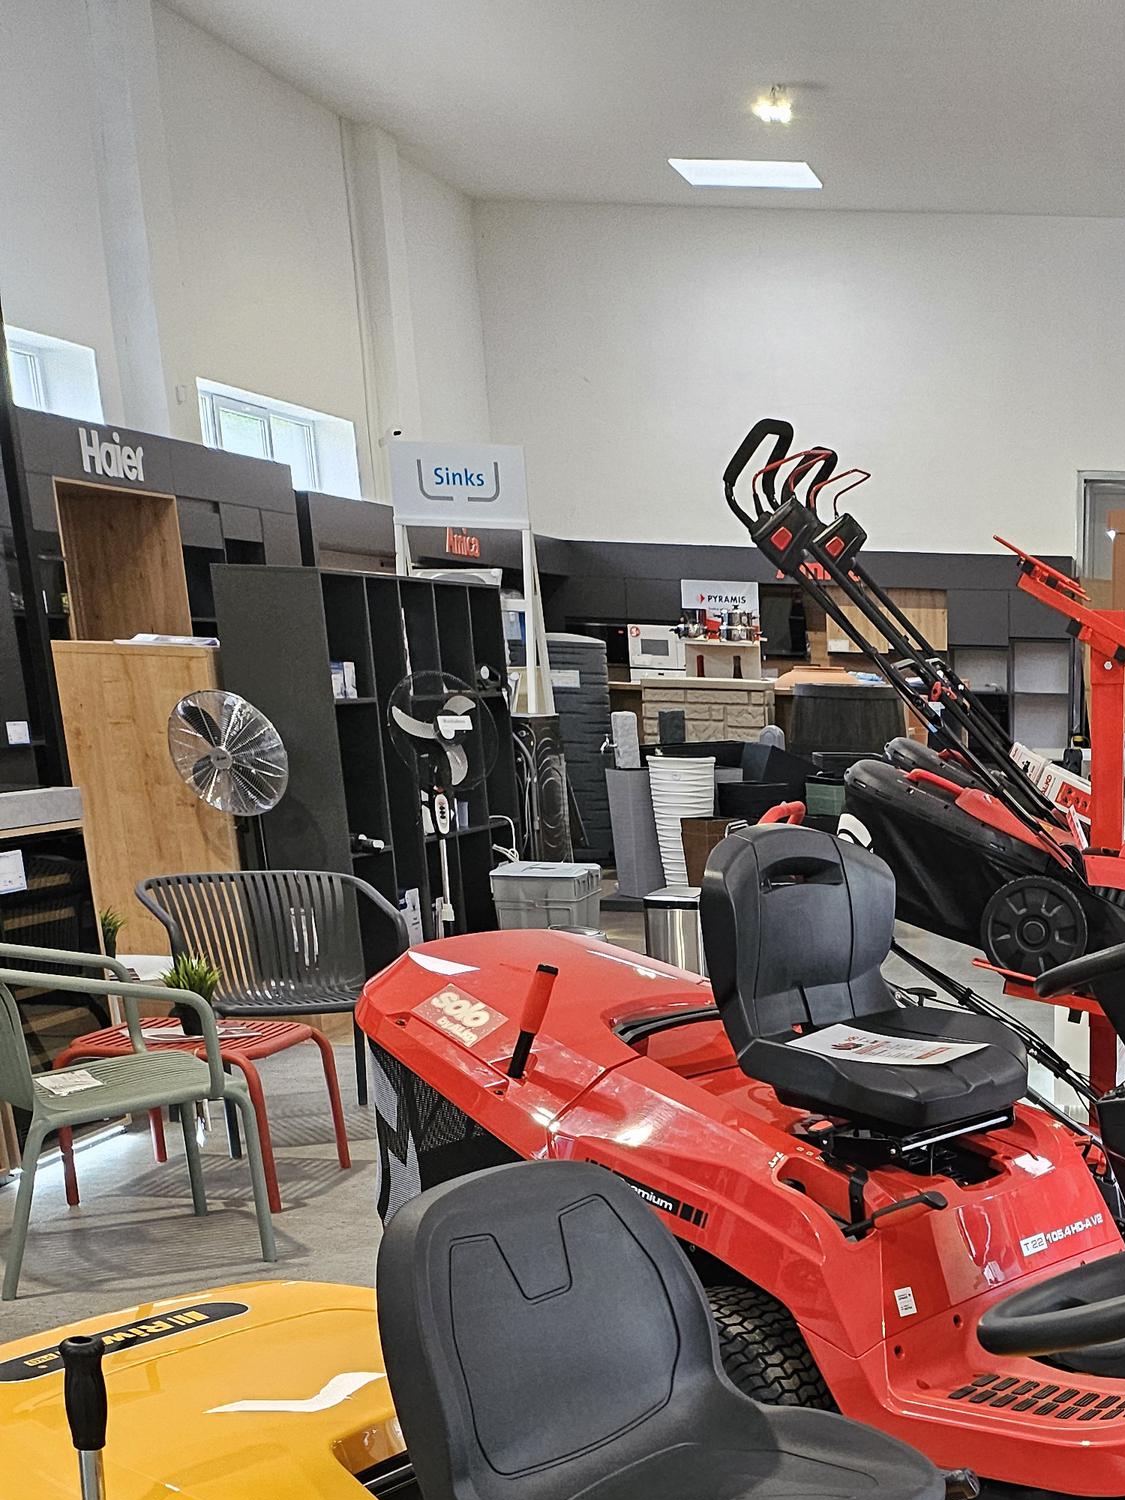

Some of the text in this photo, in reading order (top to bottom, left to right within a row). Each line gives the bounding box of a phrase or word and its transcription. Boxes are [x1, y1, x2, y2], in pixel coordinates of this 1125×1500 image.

[79, 427, 145, 482] Haier
[434, 467, 485, 486] Sinks
[707, 594, 746, 604] PYRAMIS
[1031, 1237, 1045, 1249] 22
